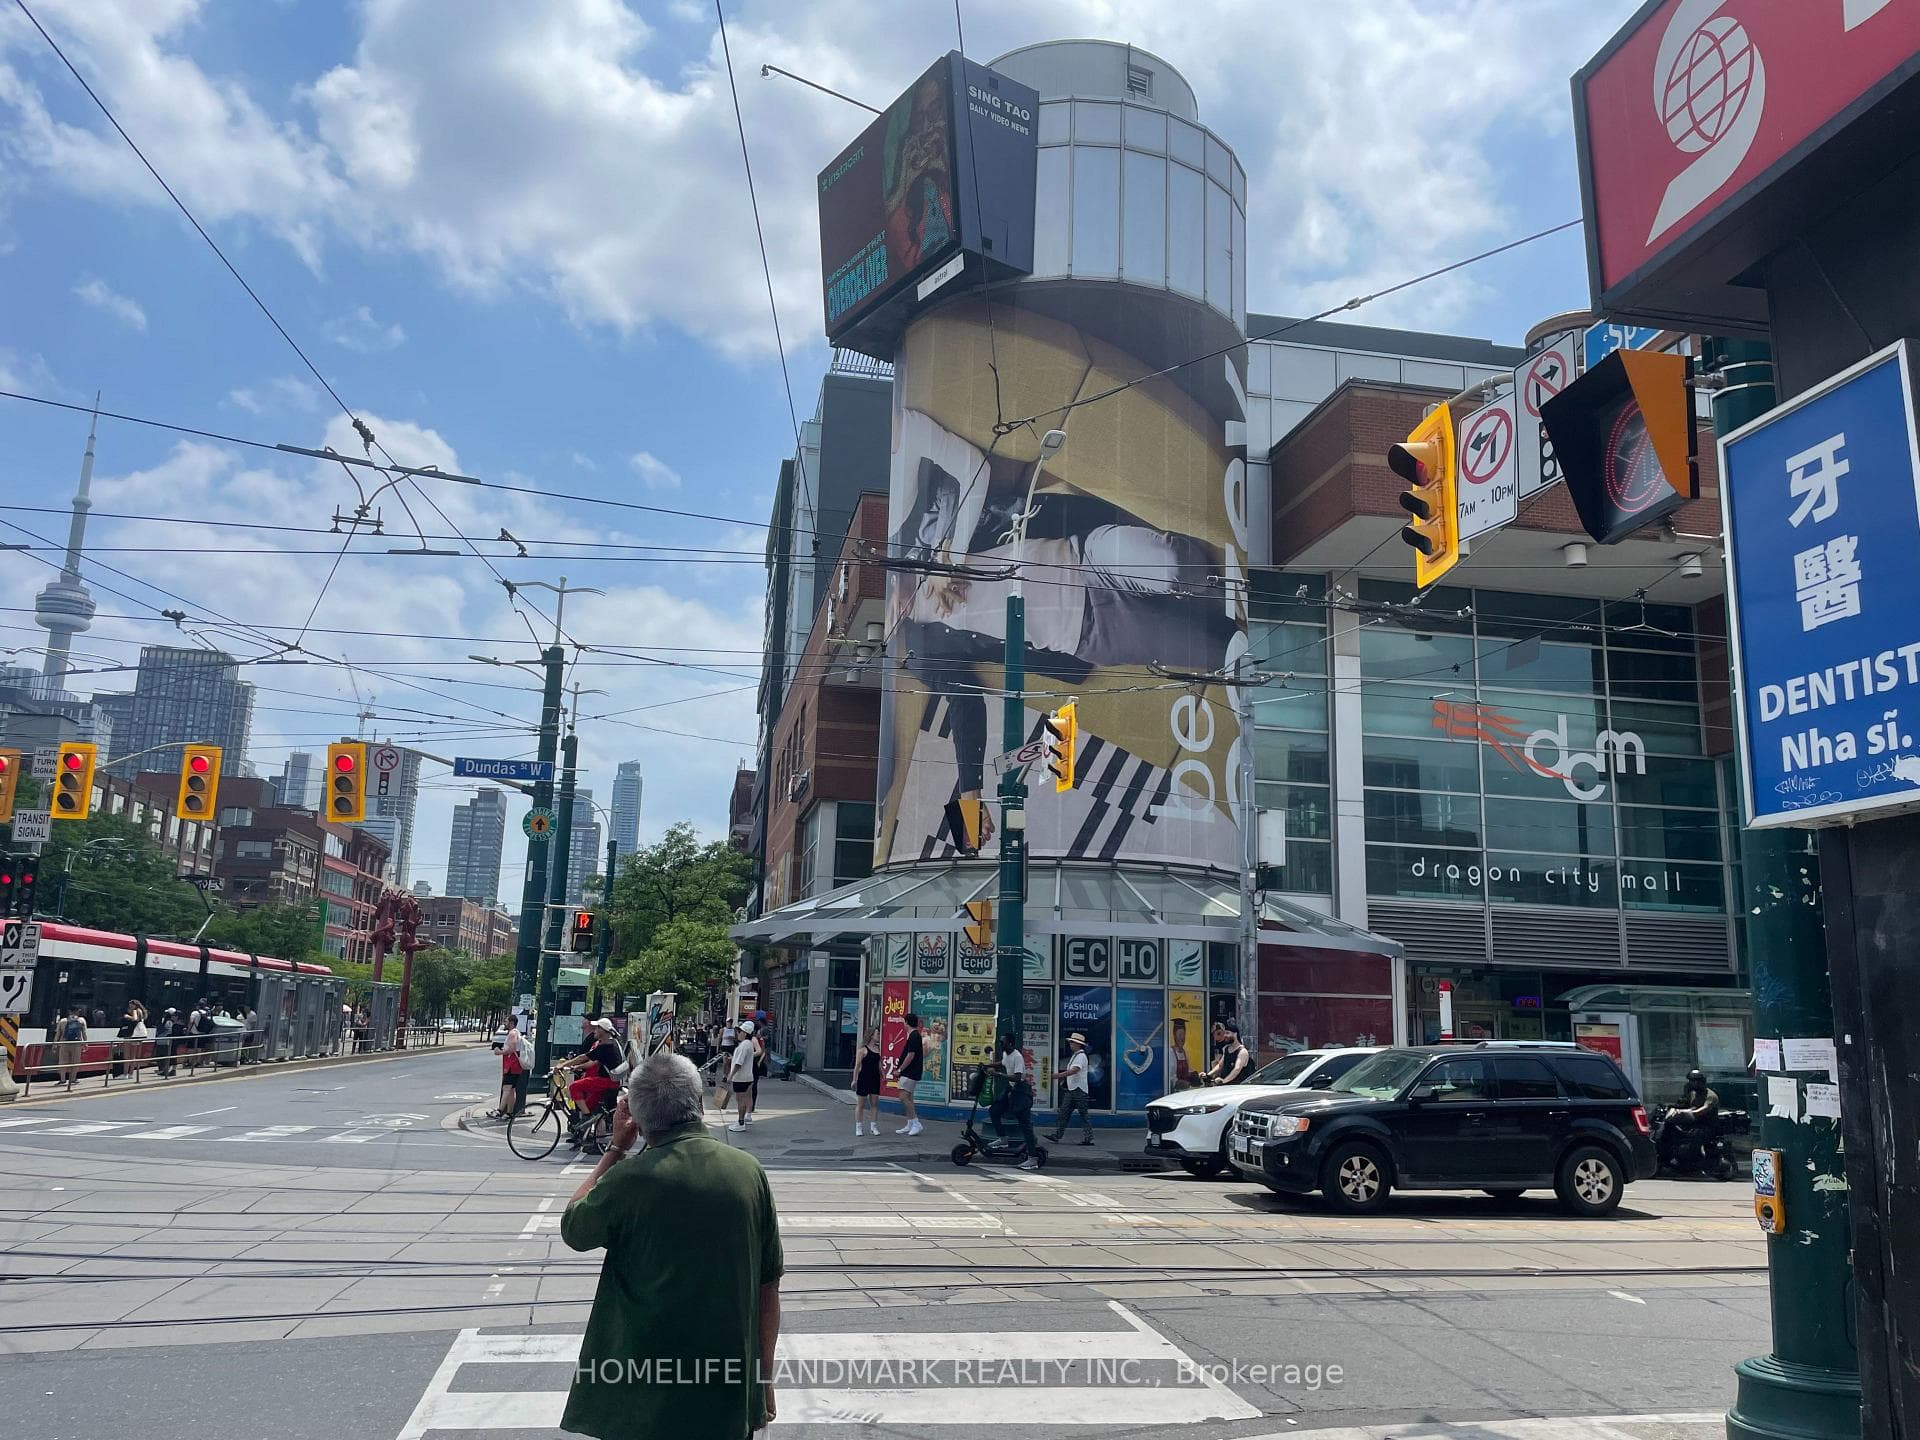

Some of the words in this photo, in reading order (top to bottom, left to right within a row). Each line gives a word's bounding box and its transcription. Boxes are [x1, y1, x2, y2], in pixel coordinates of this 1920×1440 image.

[969, 85, 1001, 109] SING
[1004, 101, 1031, 121] TAO
[969, 102, 989, 117] DAILY
[991, 111, 1010, 127] VIDEO
[1459, 501, 1476, 519] 7AM
[1491, 483, 1514, 504] 10PM
[1785, 431, 1862, 632] 牙醫
[1758, 641, 1920, 723] DENTIST
[1781, 727, 1857, 773] Nha
[465, 760, 516, 775] Dundas
[520, 762, 528, 770] St
[530, 763, 542, 776] W
[18, 812, 51, 825] TRANSIT
[17, 826, 46, 838] SIGNAL
[1411, 856, 1521, 887] dragon
[1545, 866, 1600, 893] city
[1621, 871, 1681, 892] mall
[921, 958, 943, 968] ECHO
[963, 958, 990, 968] ECHO
[885, 996, 905, 1015] Juicy
[1063, 1003, 1100, 1011] FASHION
[1063, 1012, 1099, 1020] OPTICAL
